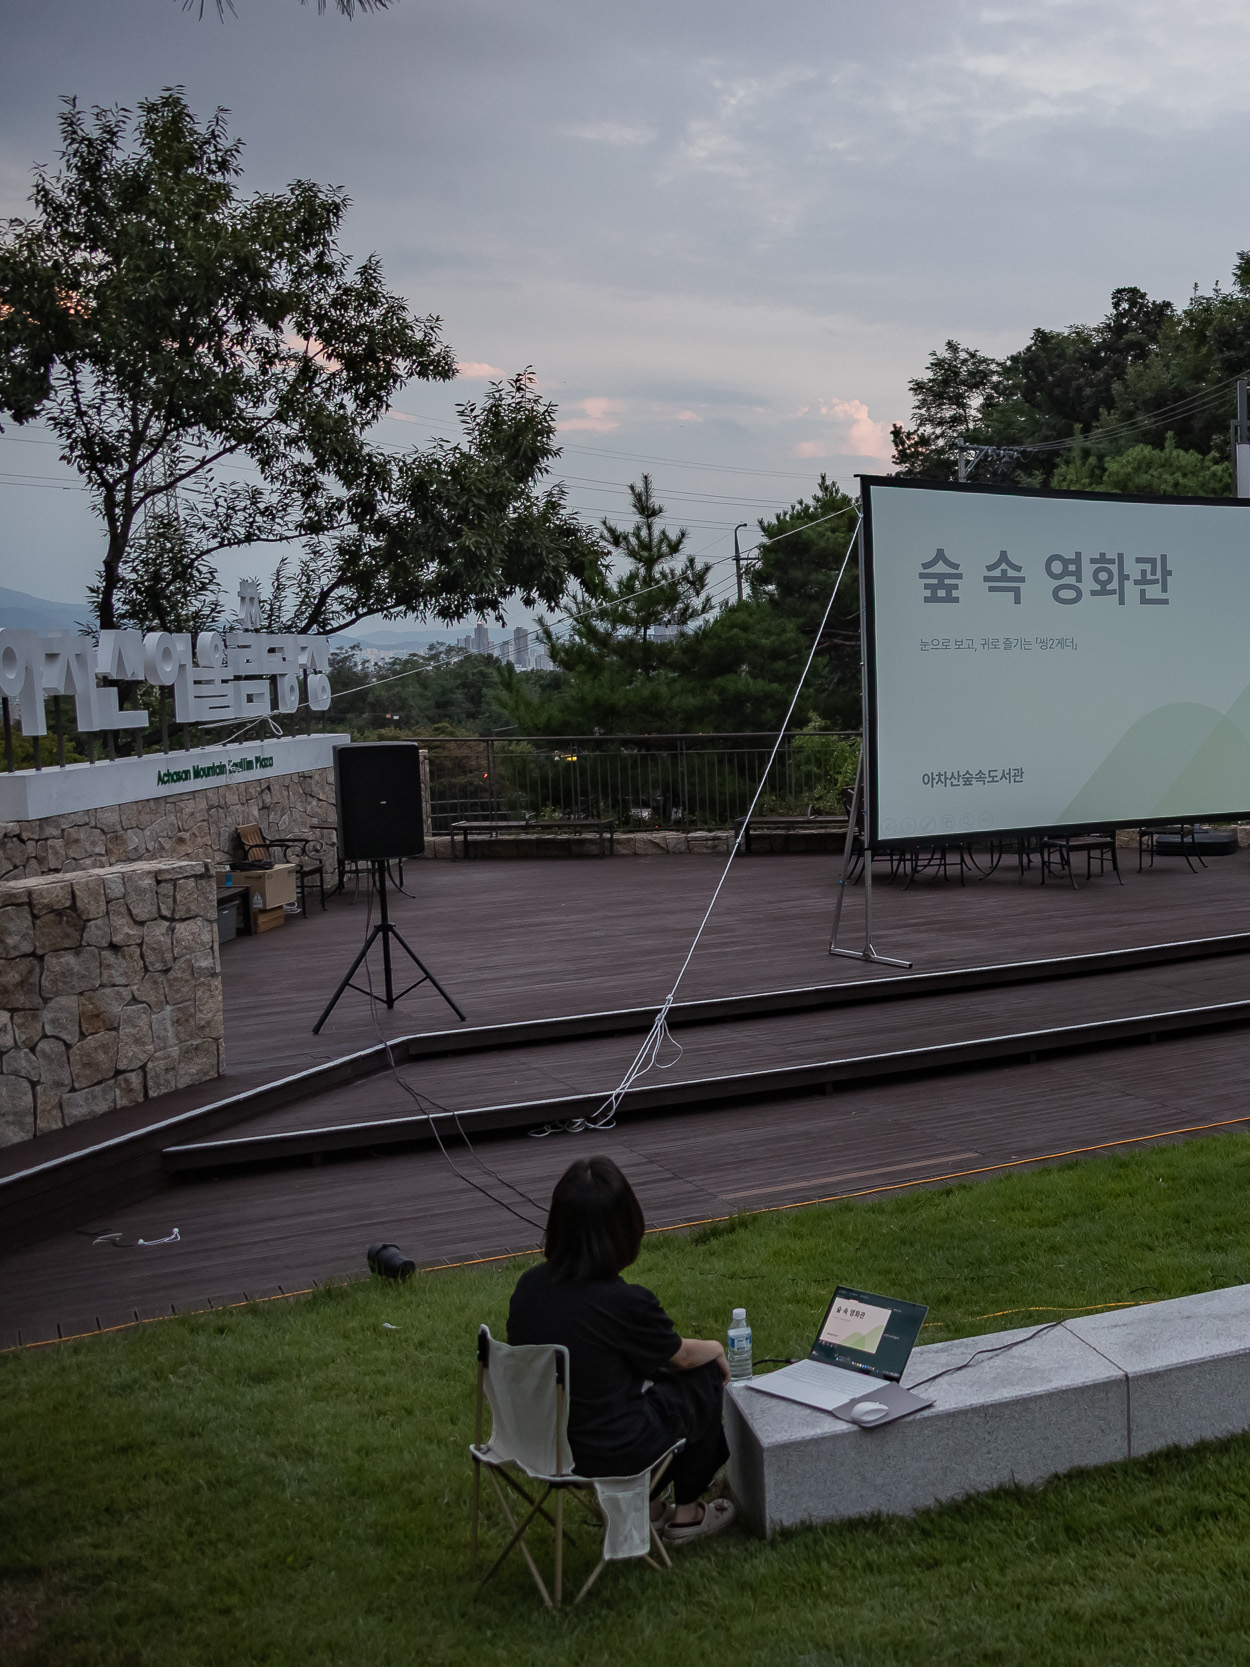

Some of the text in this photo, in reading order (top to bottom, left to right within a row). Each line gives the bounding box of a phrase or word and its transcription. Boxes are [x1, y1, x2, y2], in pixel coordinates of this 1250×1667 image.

[918, 547, 1173, 606] 숲 속 영화관
[919, 637, 952, 652] 눈으로
[953, 637, 978, 653] 보고,
[979, 637, 1001, 651] 귀로
[1002, 637, 1033, 651] 즐기는
[157, 769, 192, 786] Achasan
[192, 762, 227, 779] Mountain
[254, 756, 274, 769] Plaza
[921, 766, 1025, 789] 아차산숲속도서관
